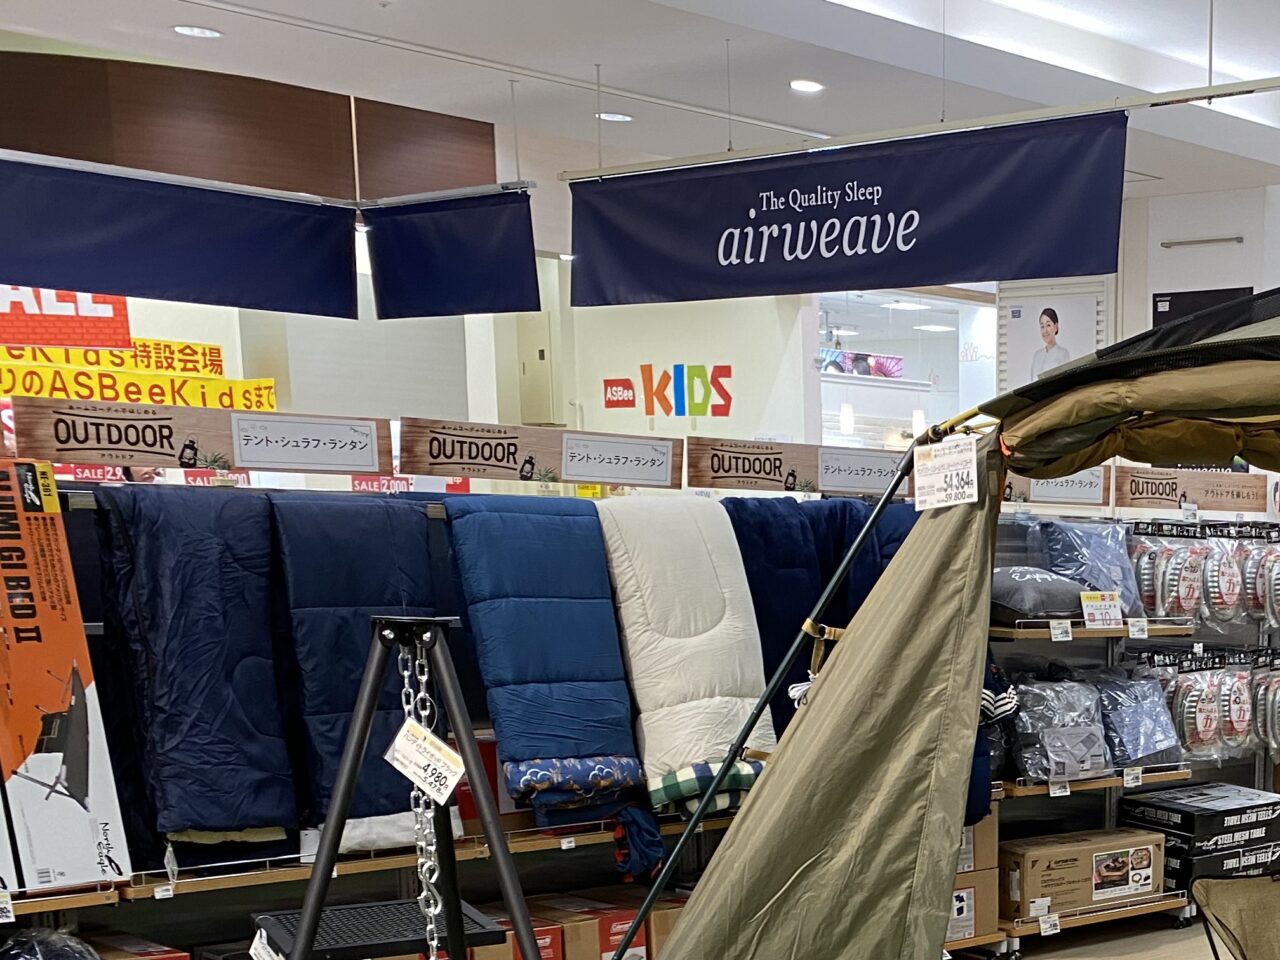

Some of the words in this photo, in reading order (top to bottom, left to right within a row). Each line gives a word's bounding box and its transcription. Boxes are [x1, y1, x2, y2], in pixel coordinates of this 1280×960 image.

[759, 191, 785, 211] The
[789, 185, 841, 212] Quality
[845, 181, 882, 205] Sleep
[717, 208, 920, 266] airweave
[606, 386, 633, 401] ASBee
[640, 364, 732, 417] KIDS
[54, 417, 175, 451] OUTDOOR
[242, 434, 369, 452] テント・シュラフ・ランタン
[429, 436, 519, 465] OUTDOOR
[568, 451, 665, 468] テント・シュラフ・ランタン
[76, 468, 103, 480] SALE
[710, 453, 784, 478] OUTDOOR
[823, 465, 898, 479] テント・シュラフ・ランタ
[187, 476, 214, 487] SAL
[354, 479, 379, 491] SALE
[1130, 479, 1178, 499] OUTDOOR
[3, 575, 37, 619] BED
[99, 822, 114, 855] North
[1217, 833, 1233, 845] STEEL
[1249, 827, 1266, 839] TABLE
[96, 841, 109, 875] Eagle
